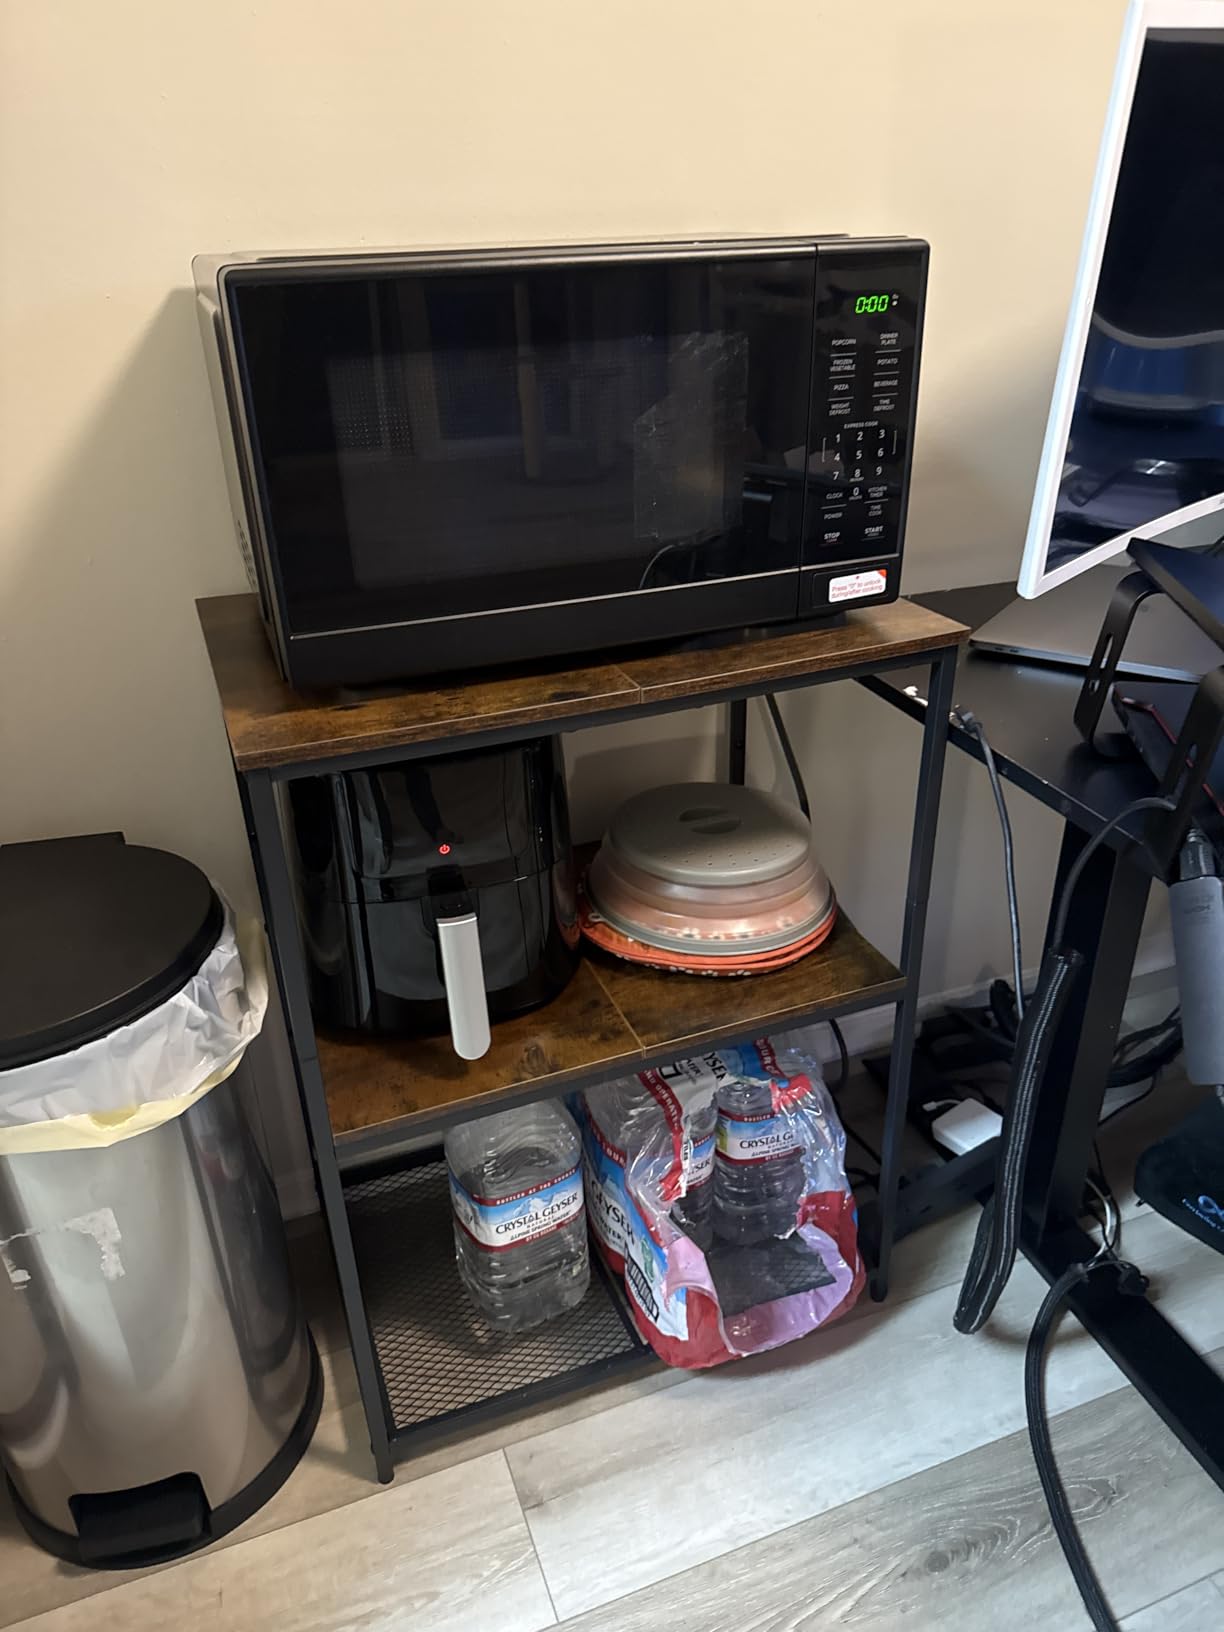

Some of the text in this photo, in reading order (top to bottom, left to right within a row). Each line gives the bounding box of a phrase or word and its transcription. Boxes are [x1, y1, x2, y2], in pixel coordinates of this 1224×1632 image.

[855, 295, 889, 313] 0:00
[831, 338, 857, 346] POPCORN
[833, 383, 849, 391] PIZZA
[873, 379, 898, 388] BEVERAGE
[828, 408, 851, 416] DEFROST
[873, 404, 895, 412] DEFROST
[835, 429, 885, 443] 1 2 3
[834, 447, 884, 462] 4 5 6
[833, 471, 840, 480] 7
[854, 468, 861, 478] 8
[876, 466, 882, 476] 9
[826, 492, 843, 500] CLOCK
[853, 487, 860, 496] 0
[823, 512, 843, 520] POWER
[864, 525, 884, 534] START
[823, 532, 841, 540] STOP
[740, 1134, 780, 1149] CRYSTAL
[495, 1211, 541, 1234] CRYSTAL
[542, 1191, 578, 1217] GEYSER
